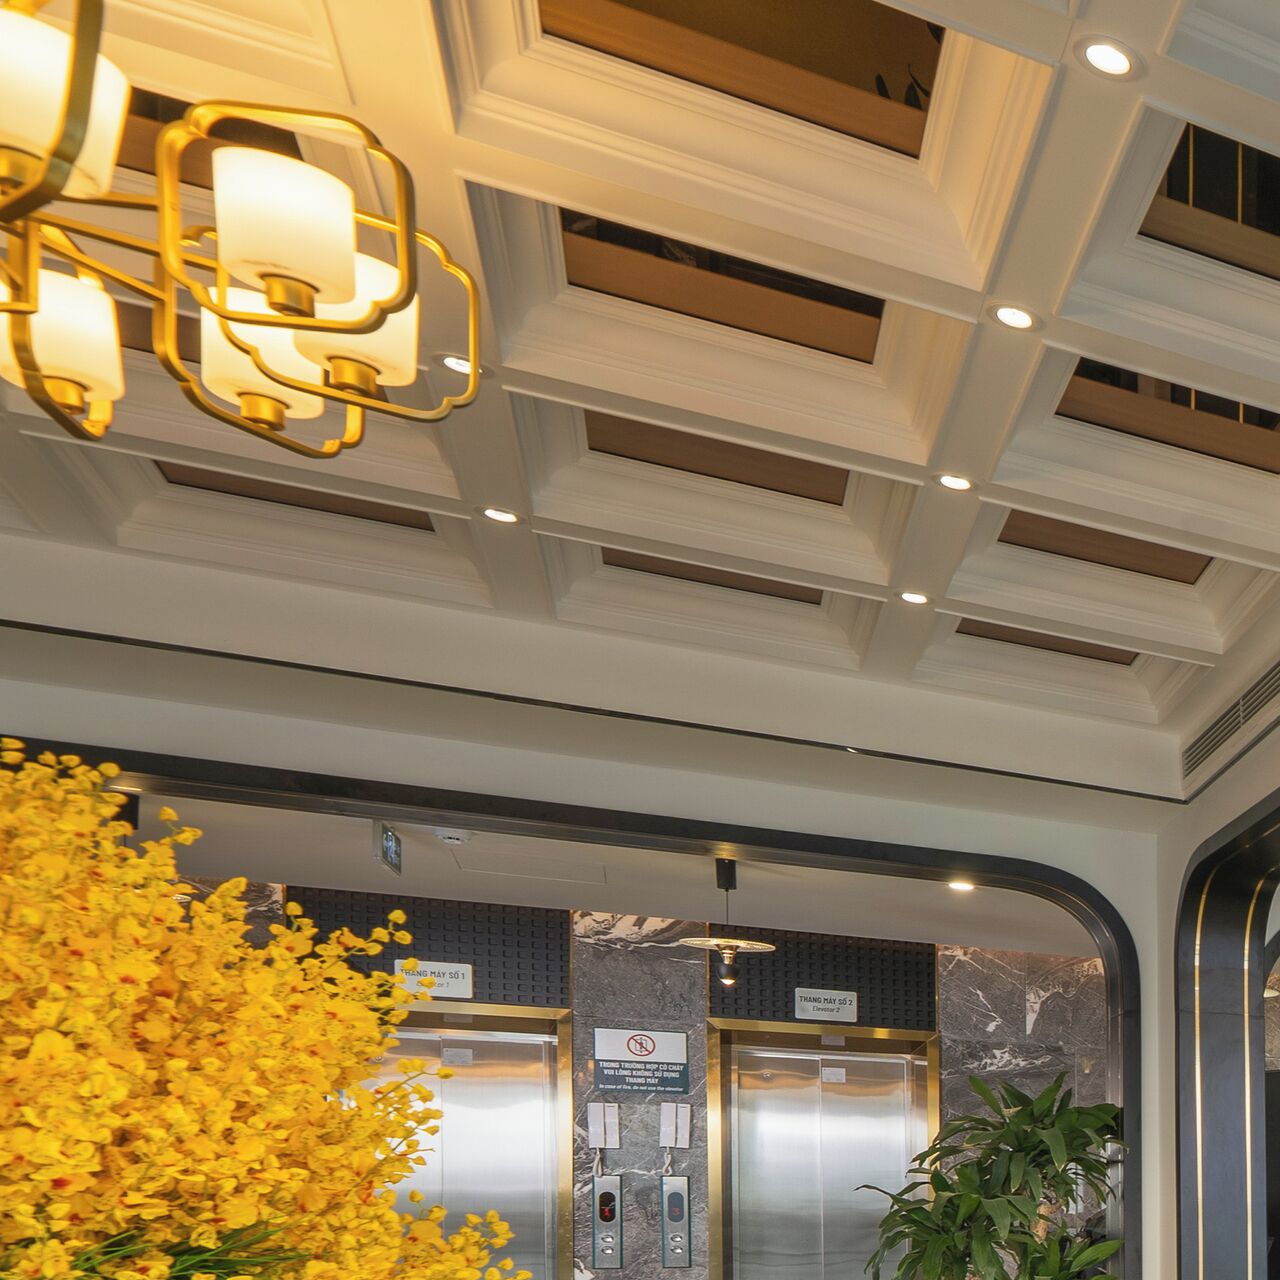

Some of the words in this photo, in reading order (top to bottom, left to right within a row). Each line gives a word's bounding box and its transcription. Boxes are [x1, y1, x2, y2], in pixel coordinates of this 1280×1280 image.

[448, 969, 459, 980] SỐ
[799, 995, 822, 1004] THANG
[823, 996, 837, 1005] MÁY
[838, 996, 847, 1006] SỐ
[812, 1005, 835, 1013] Elevator
[658, 1062, 668, 1070] CÓ
[668, 1062, 684, 1071] CHÁY
[603, 1068, 615, 1076] VUI
[632, 1069, 653, 1077] KHÔNG
[646, 1076, 659, 1084] MÁY
